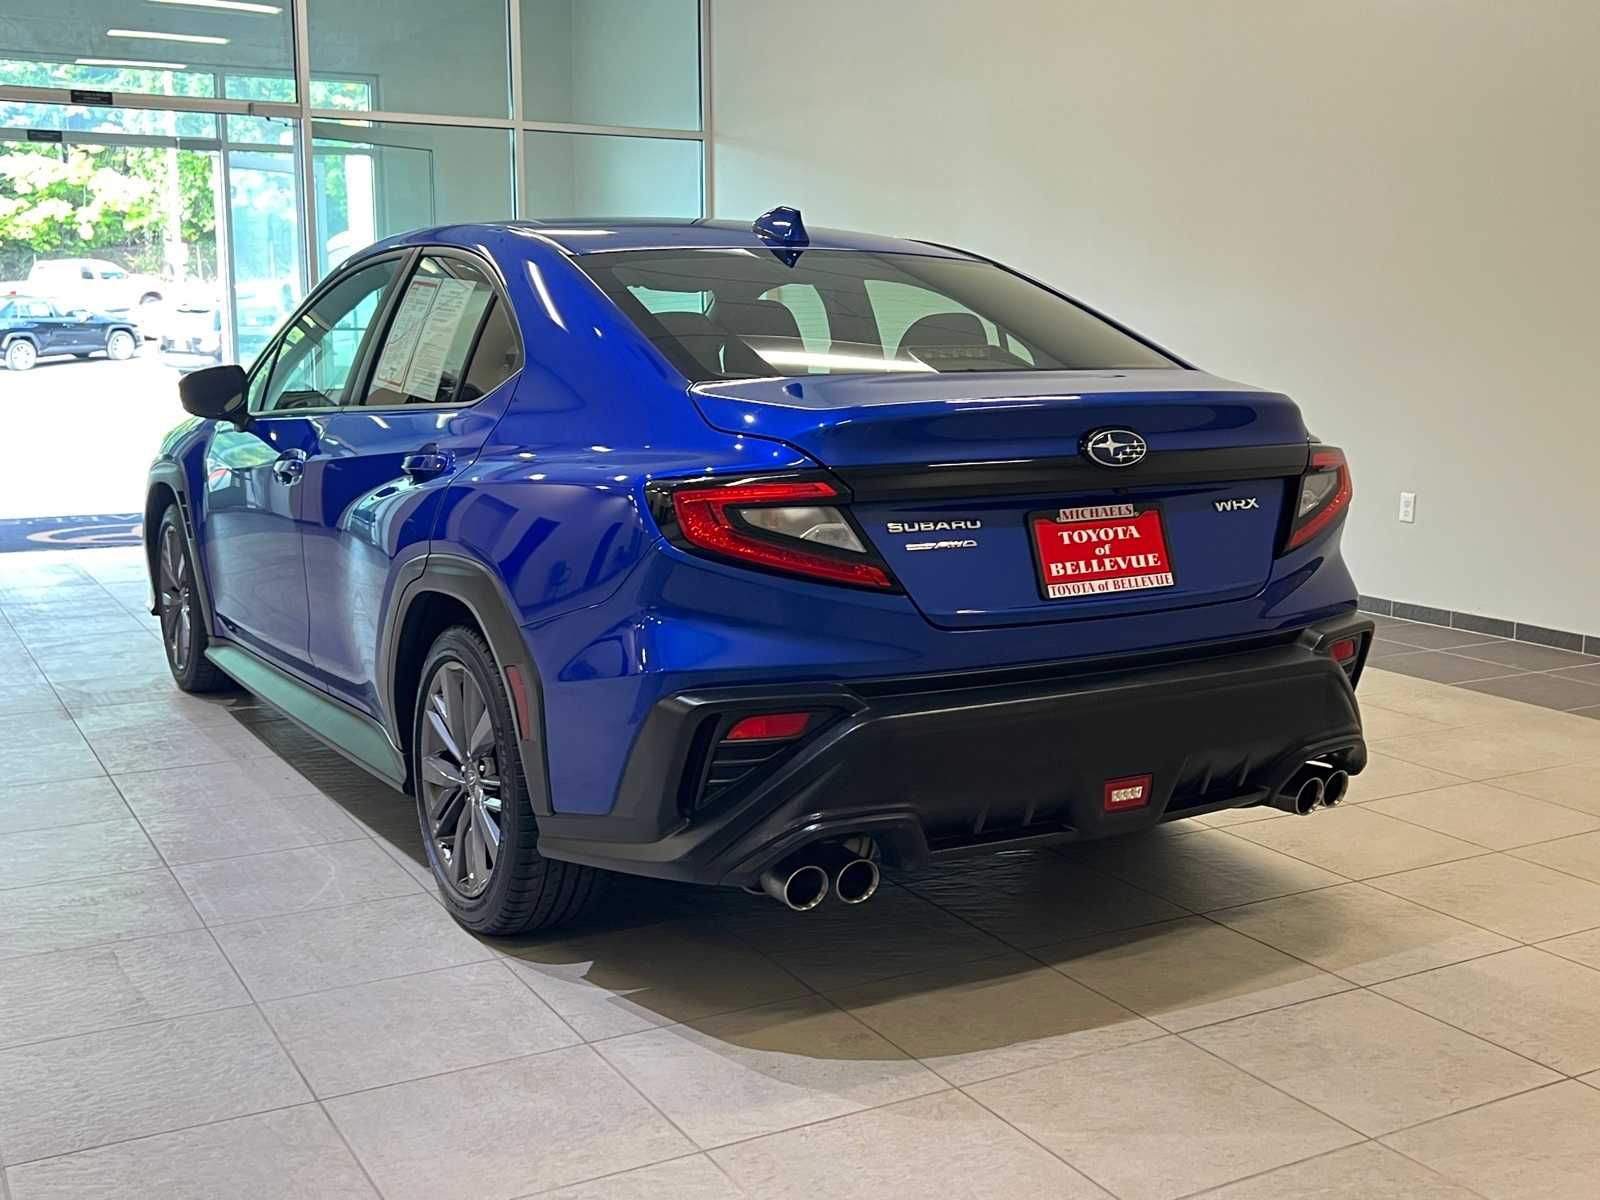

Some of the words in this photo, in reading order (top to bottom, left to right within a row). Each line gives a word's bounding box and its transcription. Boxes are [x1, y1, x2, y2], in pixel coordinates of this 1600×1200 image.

[1215, 498, 1259, 511] WRX
[1061, 505, 1132, 520] MICHAELS
[887, 520, 981, 533] SUBARU
[1058, 525, 1141, 545] TOYOTA
[1095, 543, 1111, 556] of
[1049, 553, 1161, 577] BELLEVUE
[1051, 583, 1095, 597] TOYOTA
[1098, 582, 1109, 592] of
[1112, 574, 1171, 591] BELLEVUE
